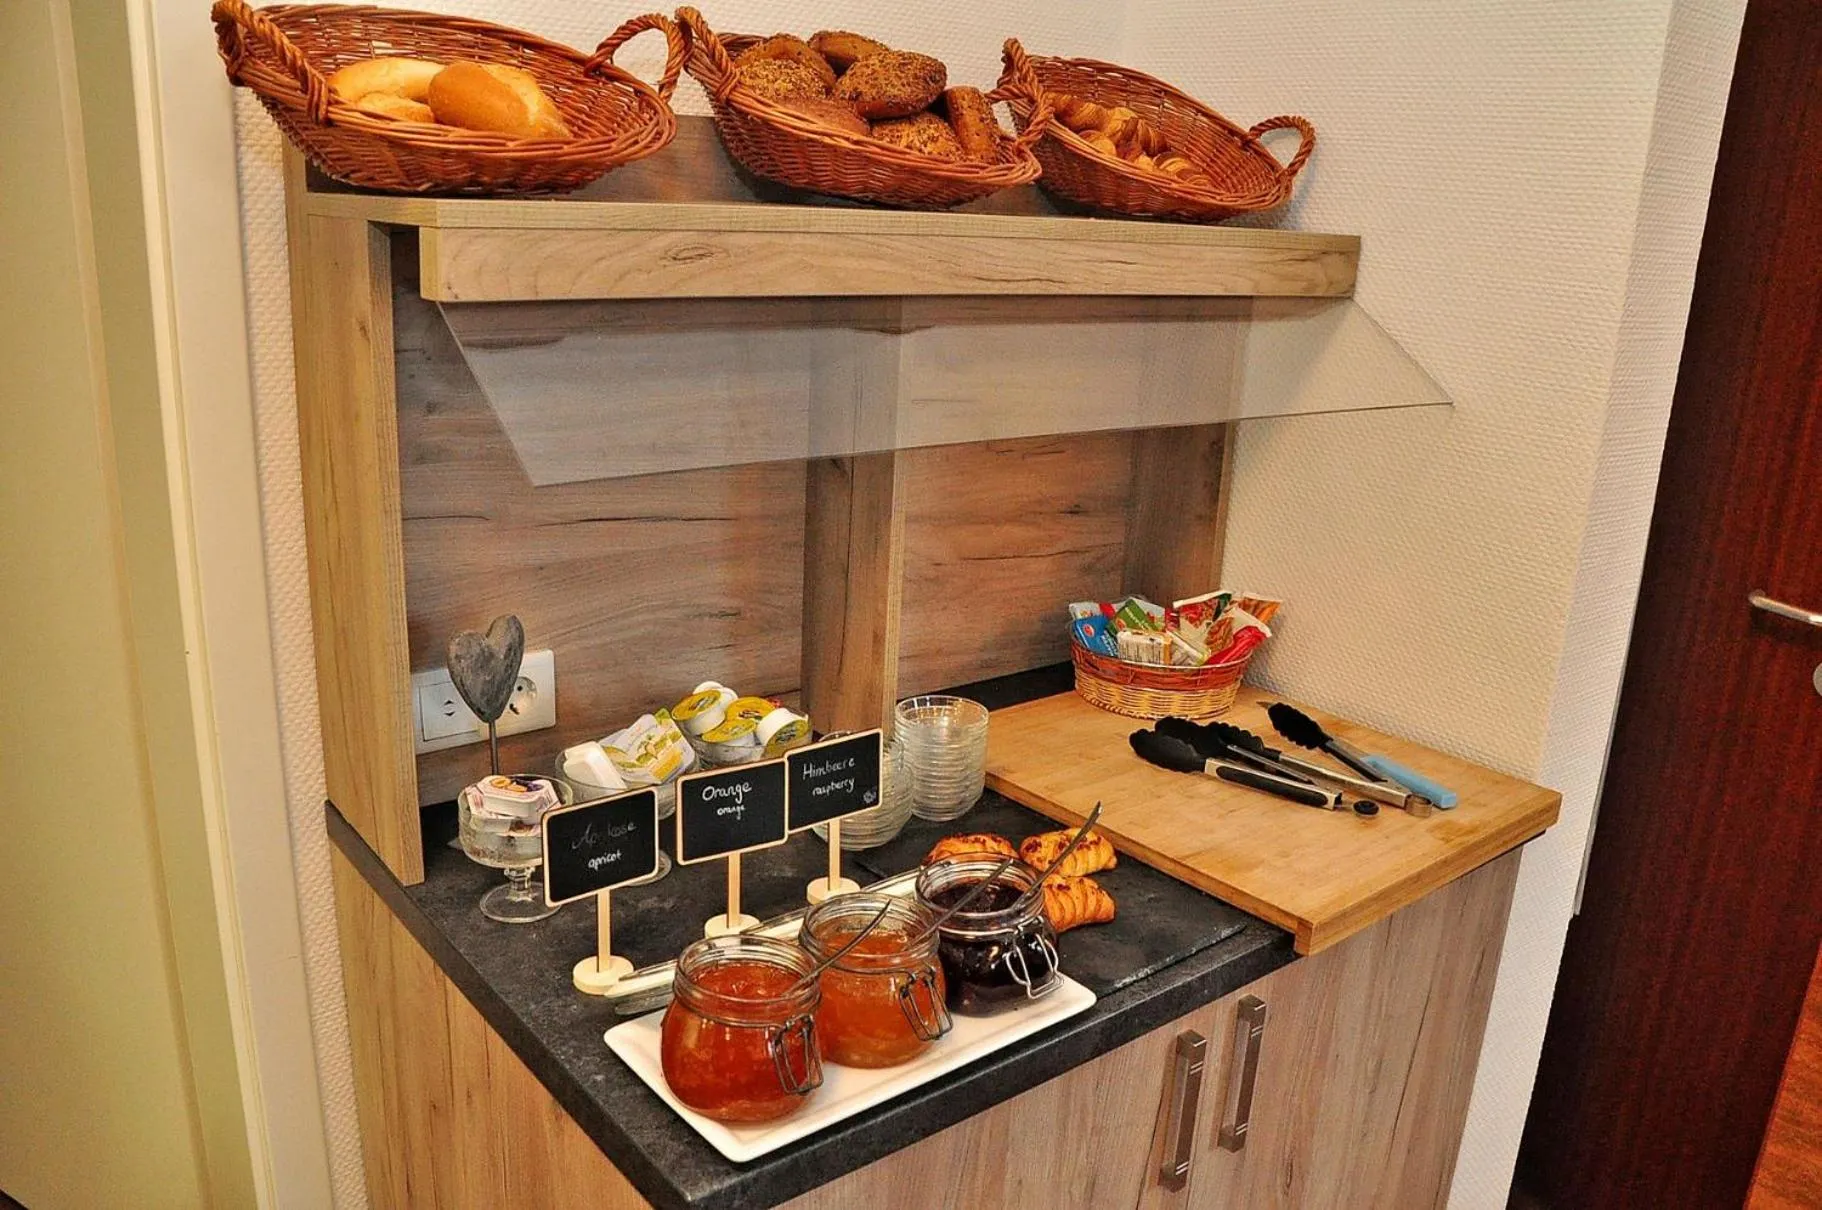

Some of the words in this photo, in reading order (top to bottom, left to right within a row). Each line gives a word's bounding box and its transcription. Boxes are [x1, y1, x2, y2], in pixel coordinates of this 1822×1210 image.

[802, 757, 856, 781] Himbeere
[702, 781, 753, 805] Orange
[717, 804, 746, 821] orange
[588, 849, 622, 872] apricot
